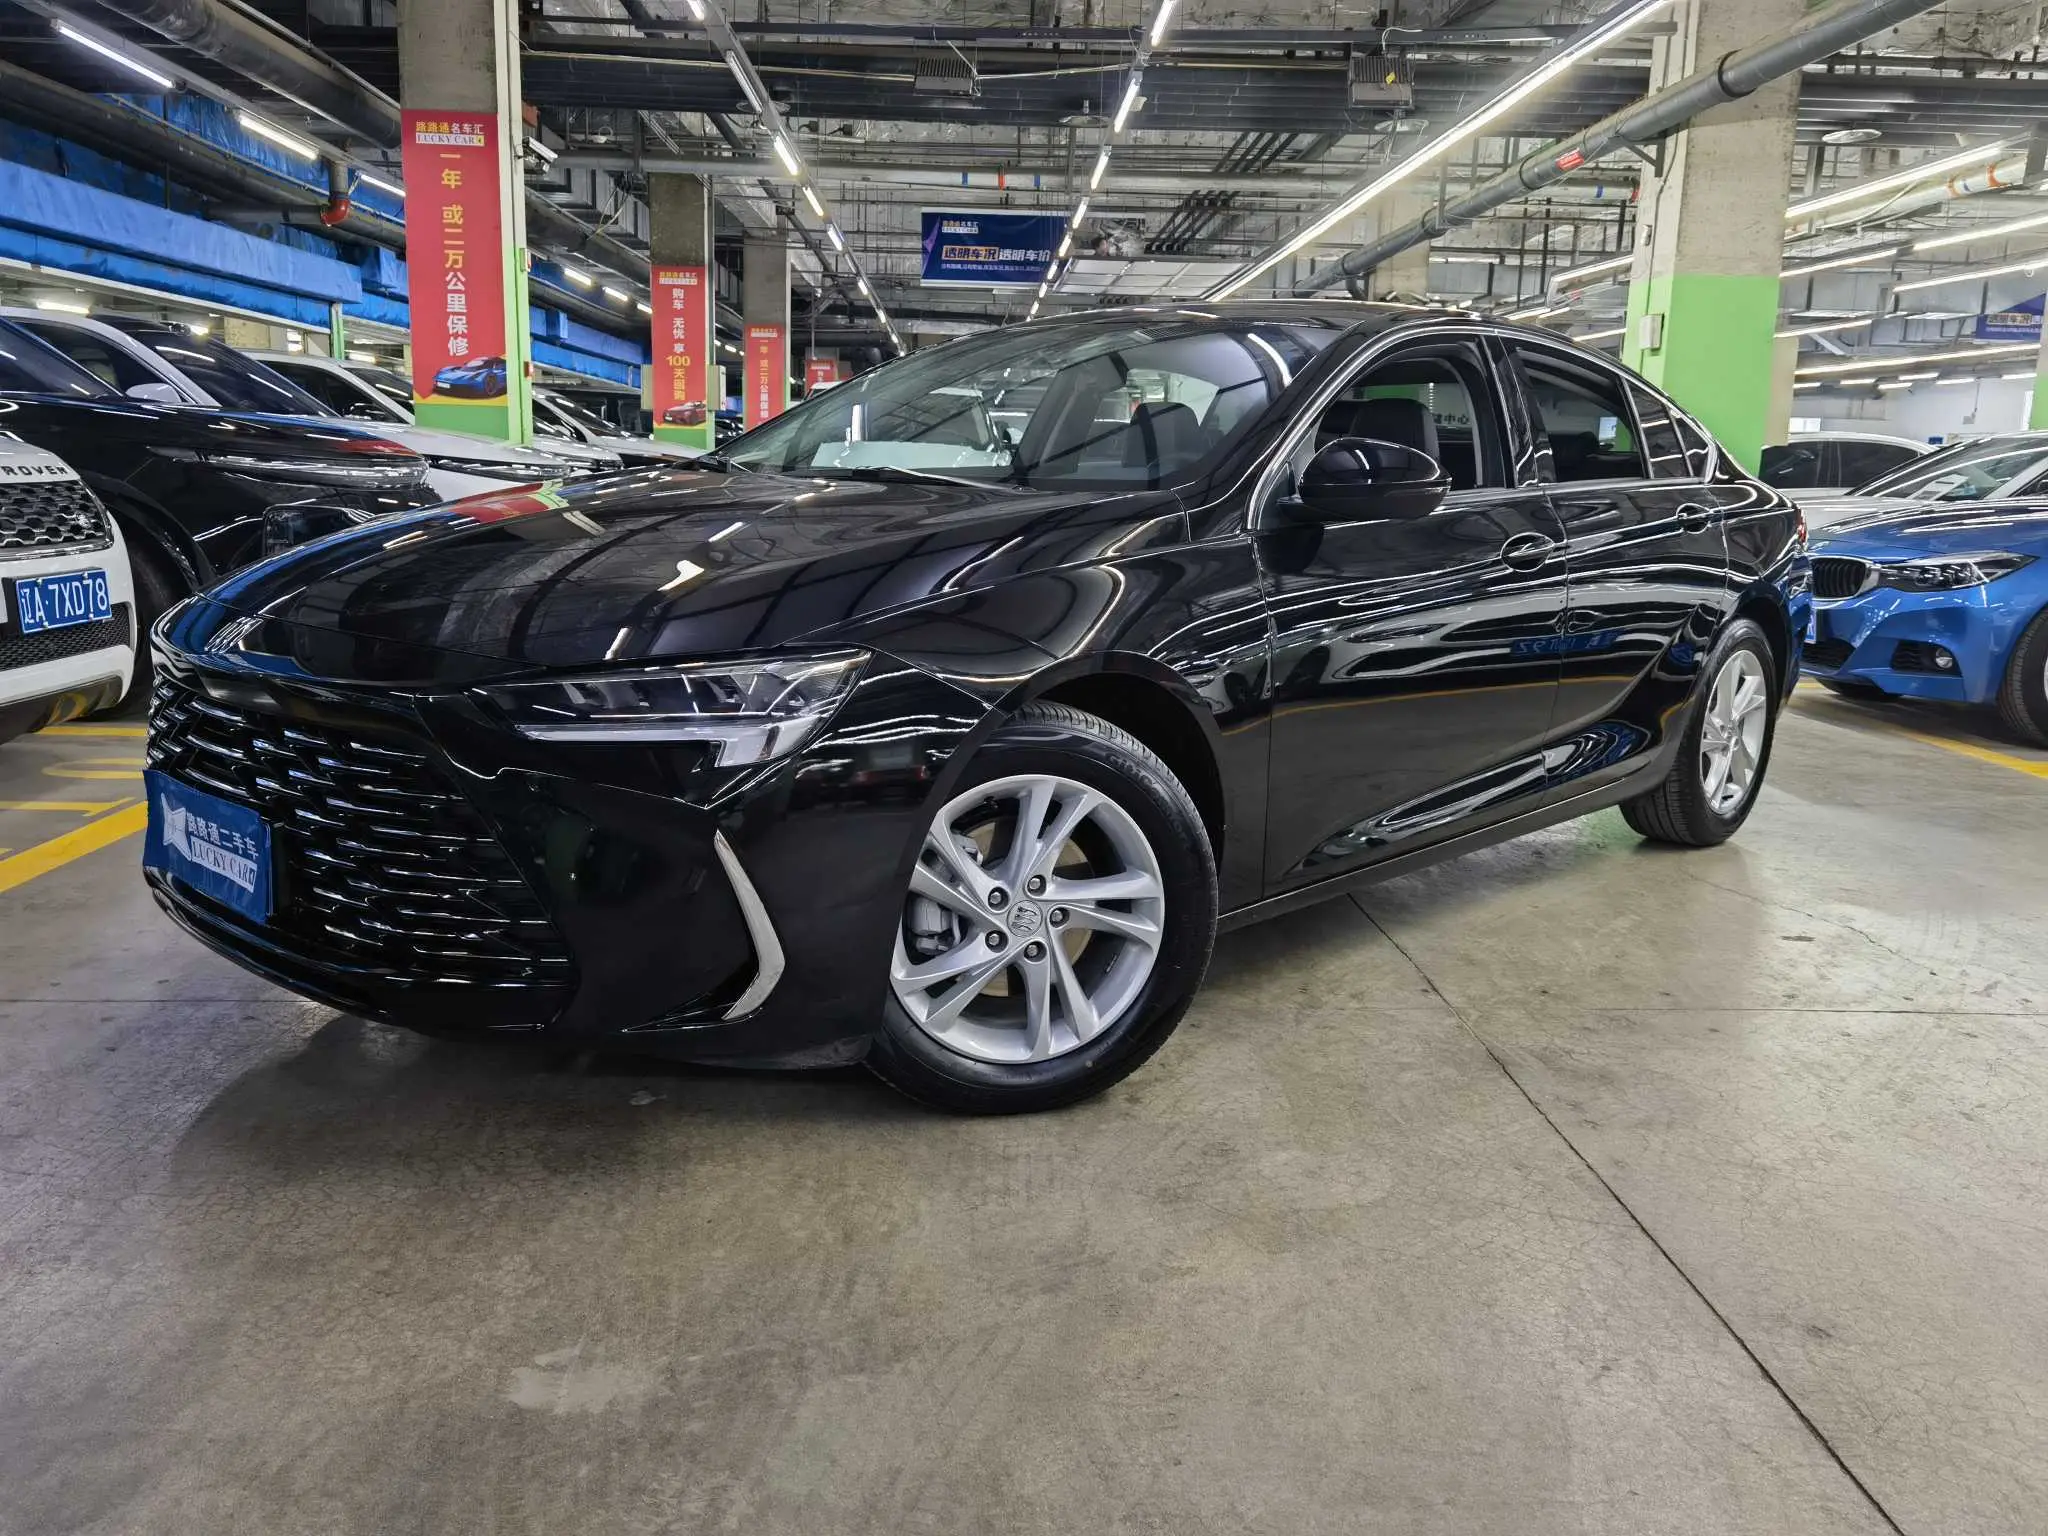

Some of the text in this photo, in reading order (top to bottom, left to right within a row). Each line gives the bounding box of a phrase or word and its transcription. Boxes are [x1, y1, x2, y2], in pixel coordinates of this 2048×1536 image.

[416, 121, 484, 134] 路路通名车汇
[417, 134, 475, 145] LUCKY CAR
[0, 465, 68, 476] ROVER
[186, 812, 259, 860] 路路通二手车
[191, 839, 249, 882] LUCKY CAR
